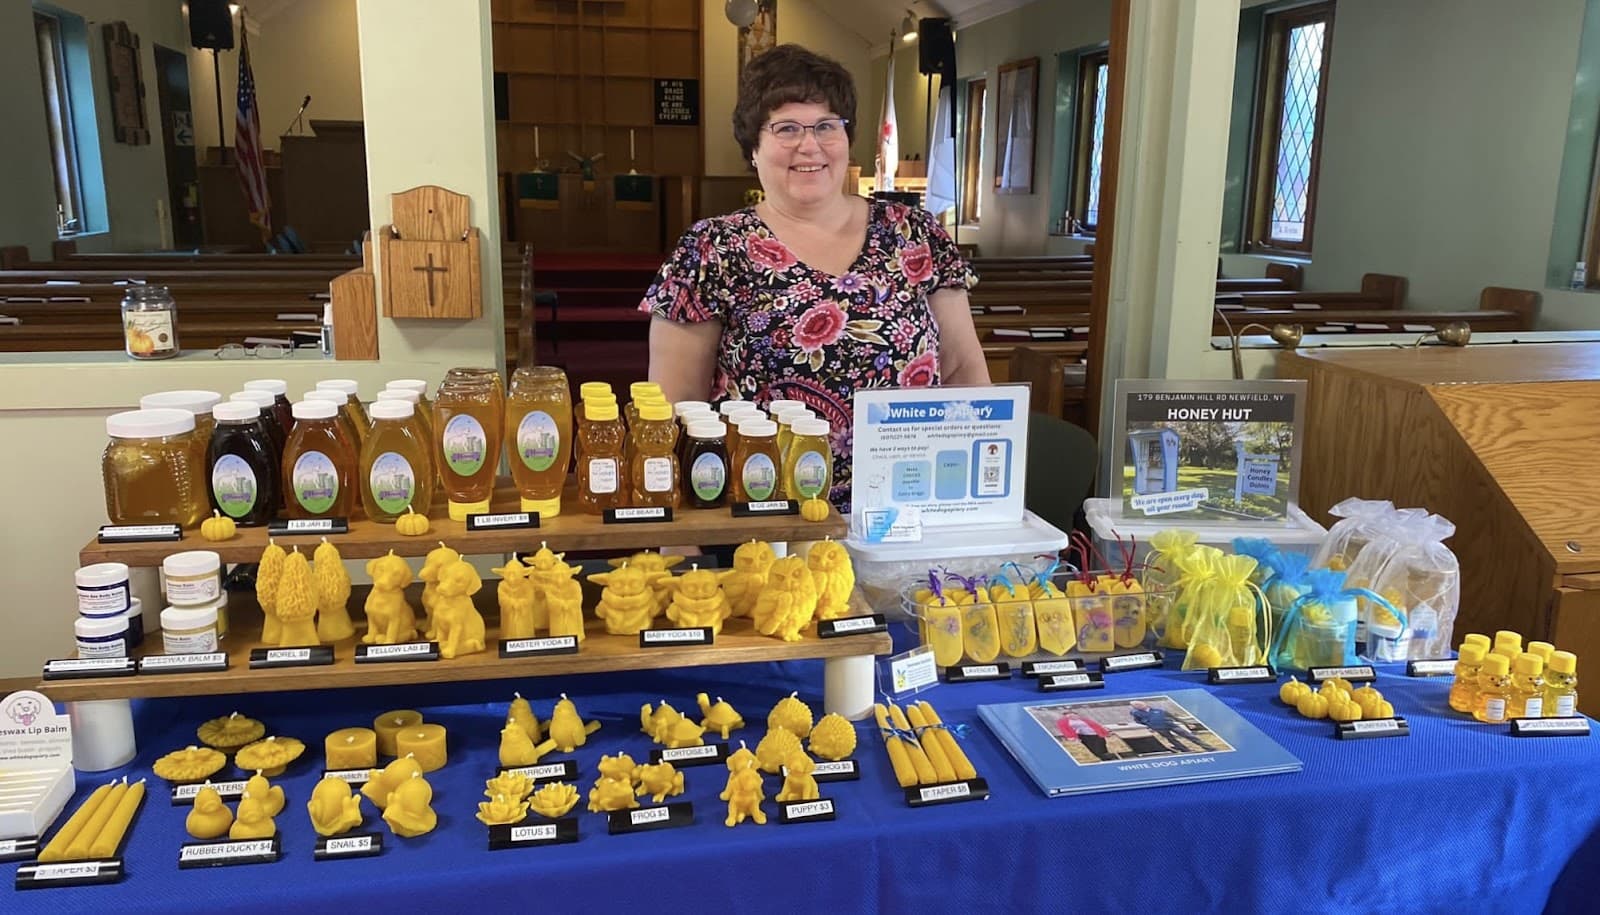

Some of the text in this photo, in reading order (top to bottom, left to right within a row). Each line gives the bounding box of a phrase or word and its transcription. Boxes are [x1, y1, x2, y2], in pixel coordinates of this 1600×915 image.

[891, 407, 926, 419] White
[1167, 408, 1252, 420] HONEY HUT
[878, 425, 902, 433] Contact
[922, 424, 943, 433] special
[646, 631, 666, 639] BABY
[509, 640, 541, 649] MASTER
[542, 639, 562, 647] YODA
[269, 651, 297, 659] MOREL
[369, 646, 402, 655] YELLOW
[403, 645, 417, 653] LAB
[29, 726, 42, 735] Lip
[45, 724, 67, 734] Balm
[666, 749, 704, 758] TORTOISE
[1118, 757, 1217, 772] WHITE DOG APIARY
[179, 785, 198, 796] BEE
[932, 786, 957, 796] TAPER
[791, 802, 830, 815] PUPPY $3
[632, 809, 667, 821] FROG $2
[515, 828, 543, 837] LOTUS
[185, 842, 271, 857] RUBBER DUCKY $4
[330, 838, 369, 850] SNAIL $5
